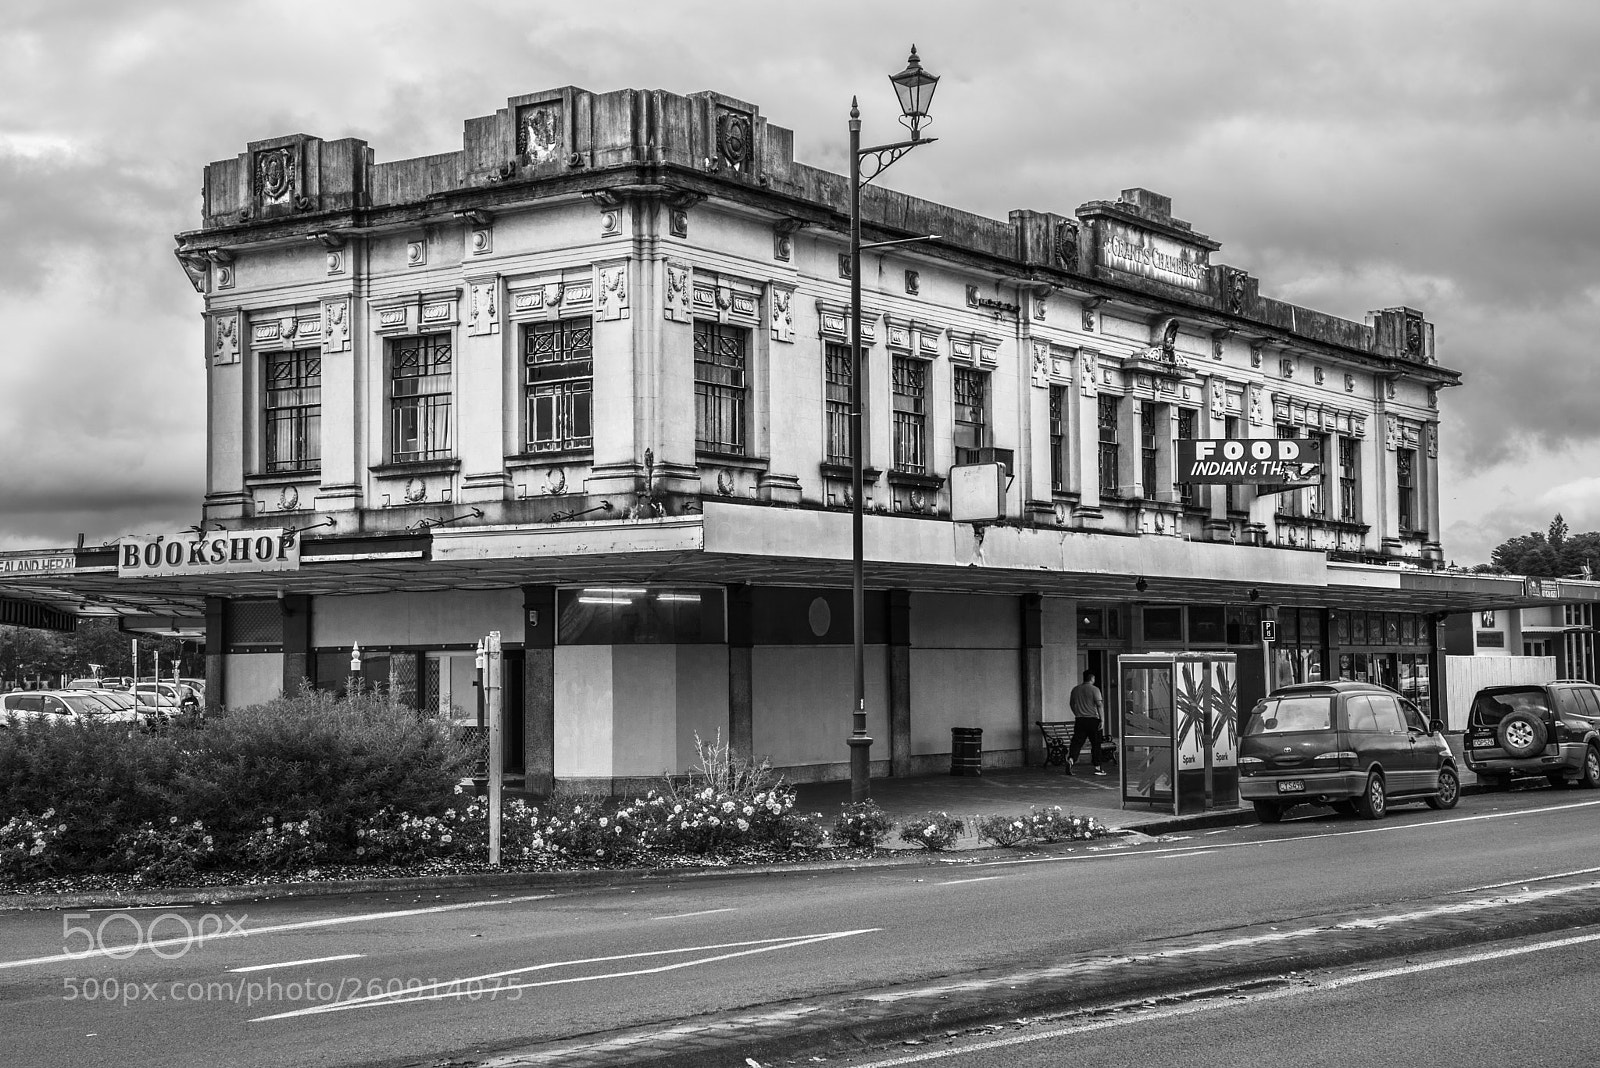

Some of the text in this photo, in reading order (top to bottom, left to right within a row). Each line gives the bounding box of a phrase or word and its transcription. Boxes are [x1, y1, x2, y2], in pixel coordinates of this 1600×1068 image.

[1152, 247, 1198, 280] CHAMBERS
[1195, 441, 1300, 460] FOOD
[1190, 461, 1285, 476] INDIAN & TH
[121, 536, 297, 569] BOOKSHOP
[1182, 754, 1195, 765] Spark
[1215, 752, 1228, 763] Spark
